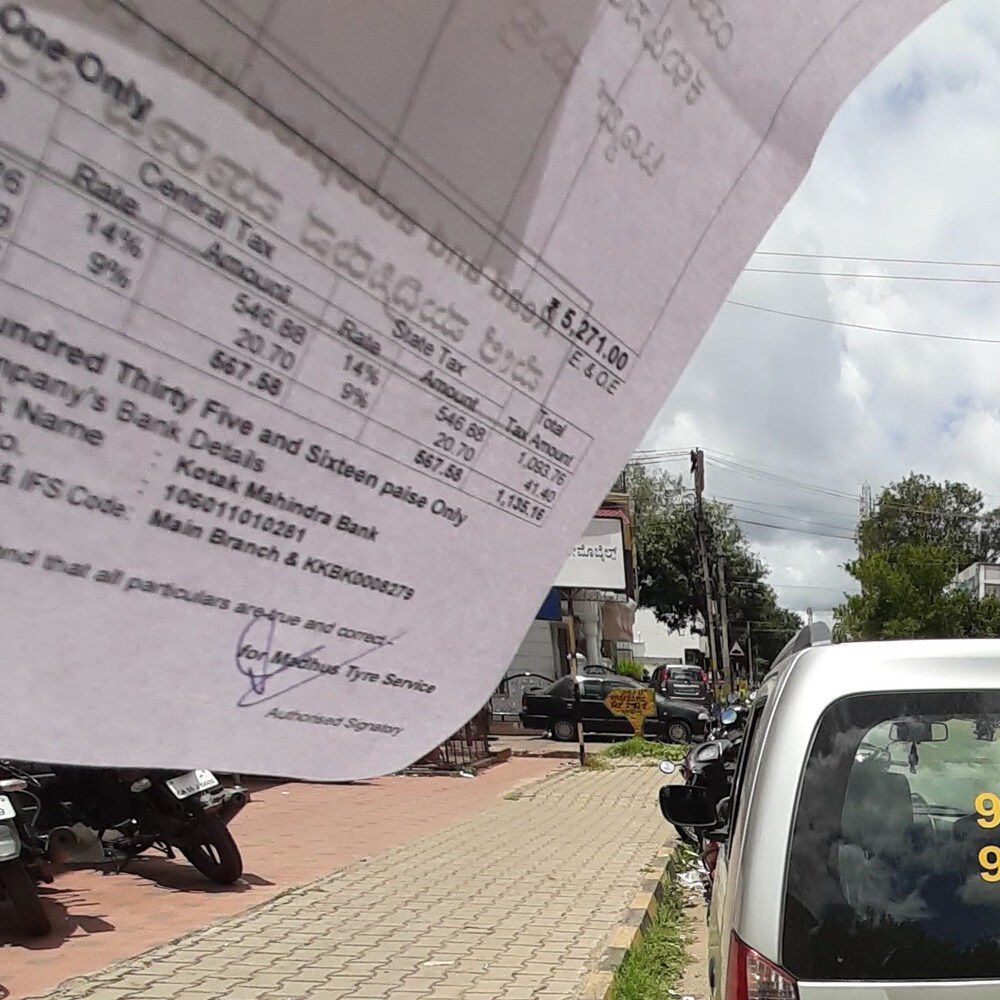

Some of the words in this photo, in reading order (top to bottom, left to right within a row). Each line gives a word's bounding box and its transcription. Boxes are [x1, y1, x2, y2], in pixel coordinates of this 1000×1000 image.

[73, 163, 139, 216] Rate
[139, 161, 227, 230] Central
[236, 216, 274, 260] Tax
[201, 242, 292, 303] Amount
[338, 318, 382, 357] Rate
[392, 318, 435, 357] State
[440, 345, 468, 377] Tax
[560, 307, 631, 372] 5,271.00
[420, 369, 481, 412] Amount
[116, 399, 183, 443] Bank
[188, 427, 267, 473] Details
[116, 359, 198, 415] Thirty
[200, 398, 255, 437] Five
[257, 426, 304, 457] and
[304, 443, 380, 491] Sixteen
[378, 478, 430, 510] paise
[430, 498, 470, 529] Only
[433, 431, 477, 463] 20.70
[506, 416, 531, 441] Tax
[528, 430, 576, 467] Amount
[538, 402, 569, 438] Total
[14, 397, 105, 447] Name
[174, 455, 241, 493] Kotak
[245, 480, 333, 526] Mahindra
[335, 514, 381, 542] Bank
[522, 478, 558, 505] 41.40
[66, 485, 128, 521] Code
[148, 508, 205, 540] Main
[208, 527, 281, 563] Branch
[284, 551, 299, 568] &
[495, 489, 546, 523] 1,135.16
[42, 554, 93, 578] that
[93, 568, 125, 586] all
[124, 574, 232, 612] particulars
[303, 617, 338, 635] and
[345, 664, 381, 685] Tyre
[384, 672, 438, 695] Service
